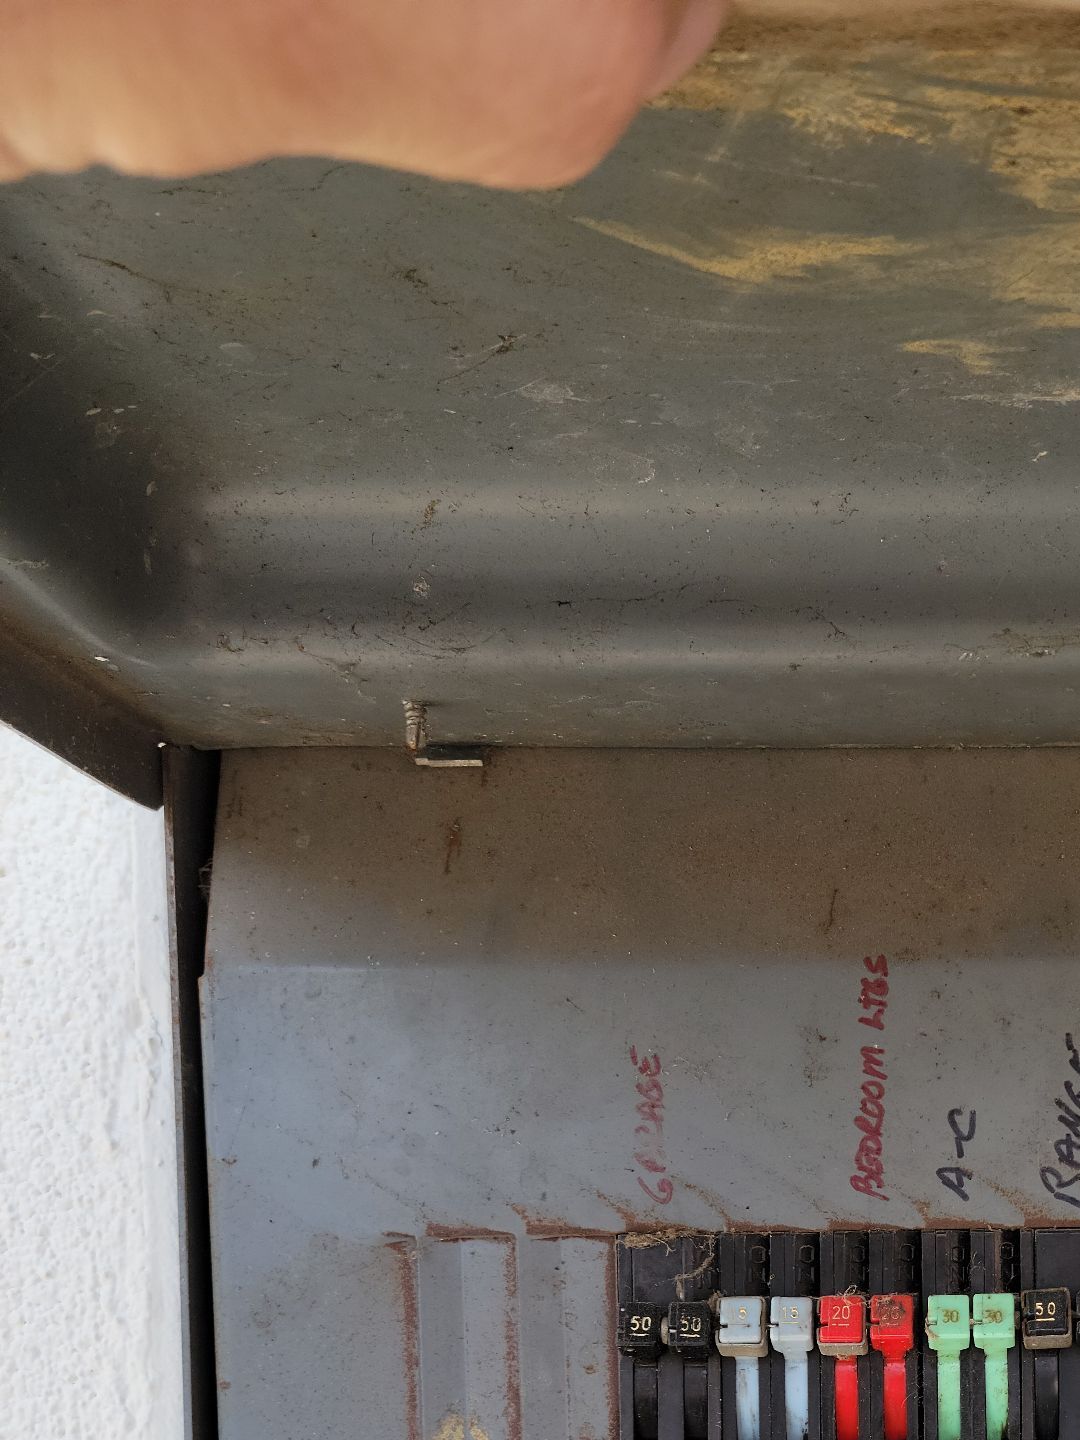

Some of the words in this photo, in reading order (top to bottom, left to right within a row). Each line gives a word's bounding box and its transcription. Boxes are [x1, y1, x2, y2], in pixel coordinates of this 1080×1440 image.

[733, 1306, 748, 1319] 5
[782, 1306, 799, 1319] 15
[832, 1305, 851, 1319] 20
[1035, 1301, 1056, 1315] 50
[942, 1309, 960, 1322] 30
[631, 1316, 651, 1330] 50
[681, 1317, 701, 1331] 50
